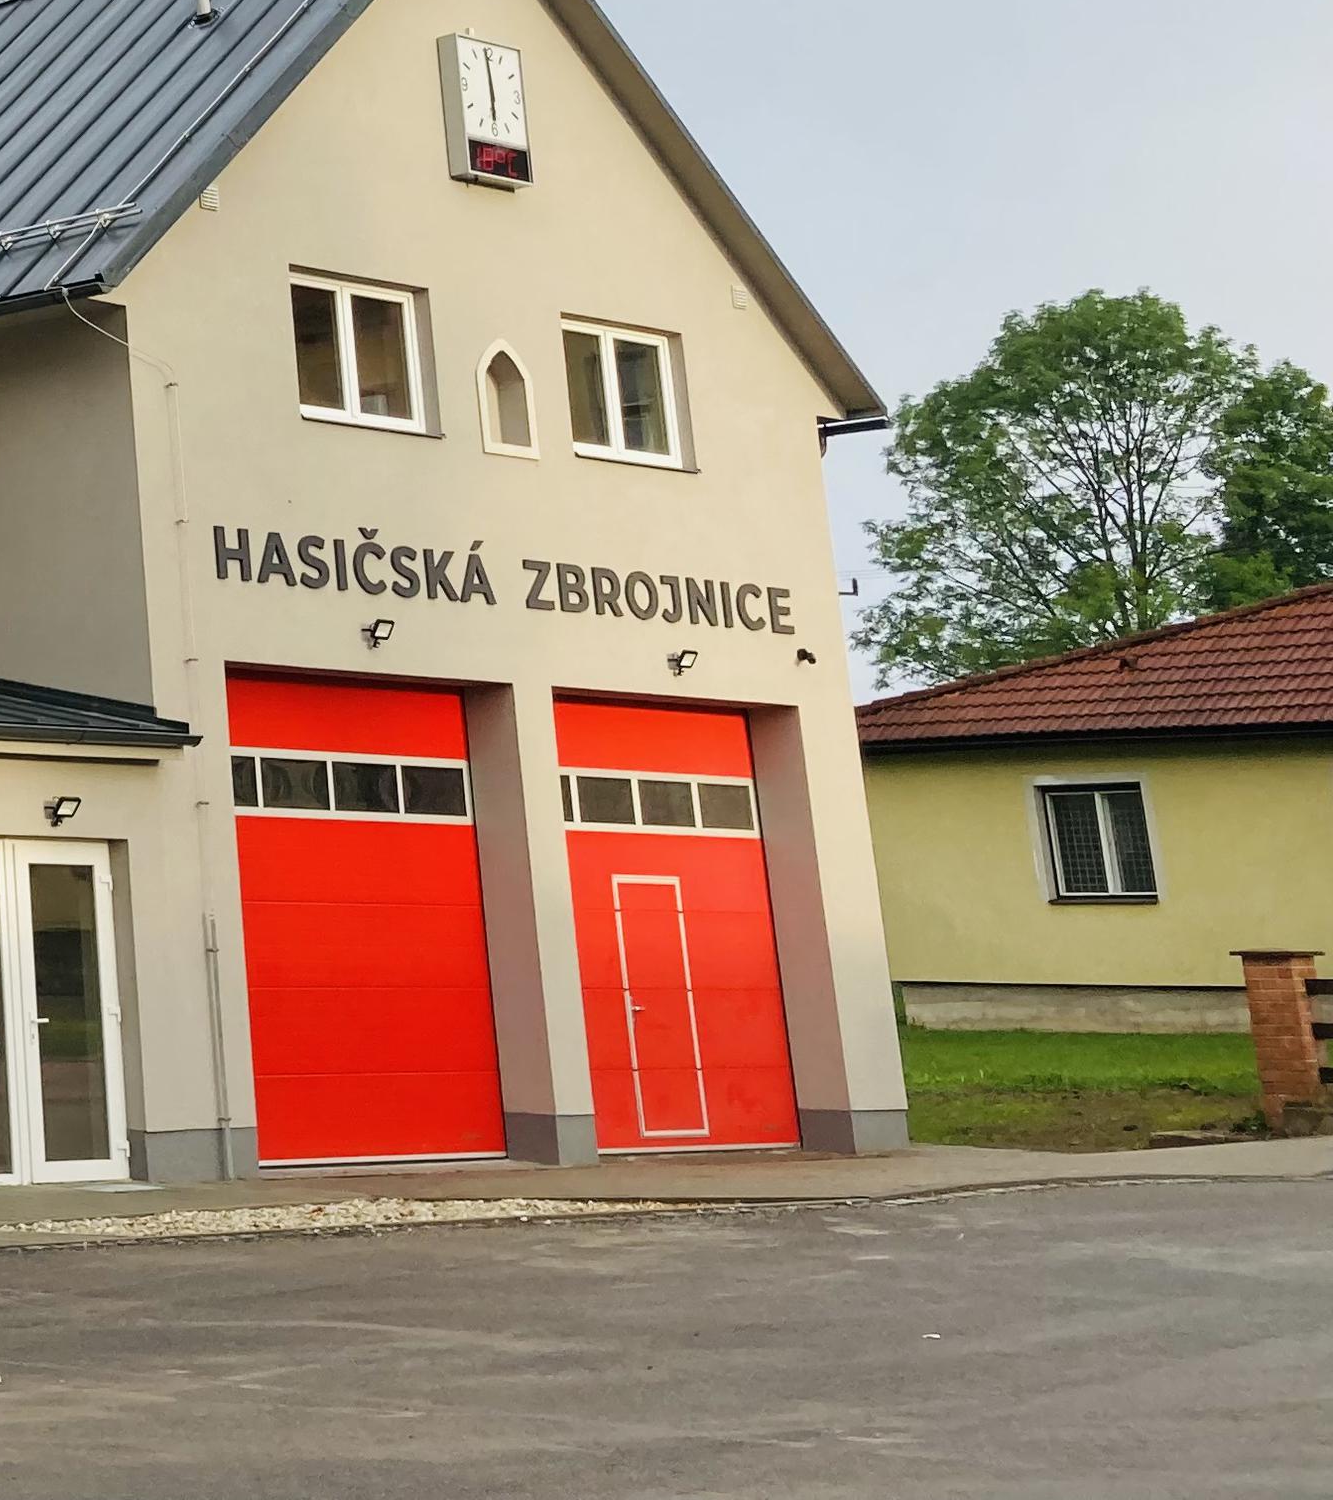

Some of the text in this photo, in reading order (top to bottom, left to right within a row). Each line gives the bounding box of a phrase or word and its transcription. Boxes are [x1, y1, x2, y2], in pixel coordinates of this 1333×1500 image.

[513, 90, 521, 105] 3
[491, 121, 499, 137] 6
[213, 525, 795, 635] HASIČSKÁ ZBROJNICE
